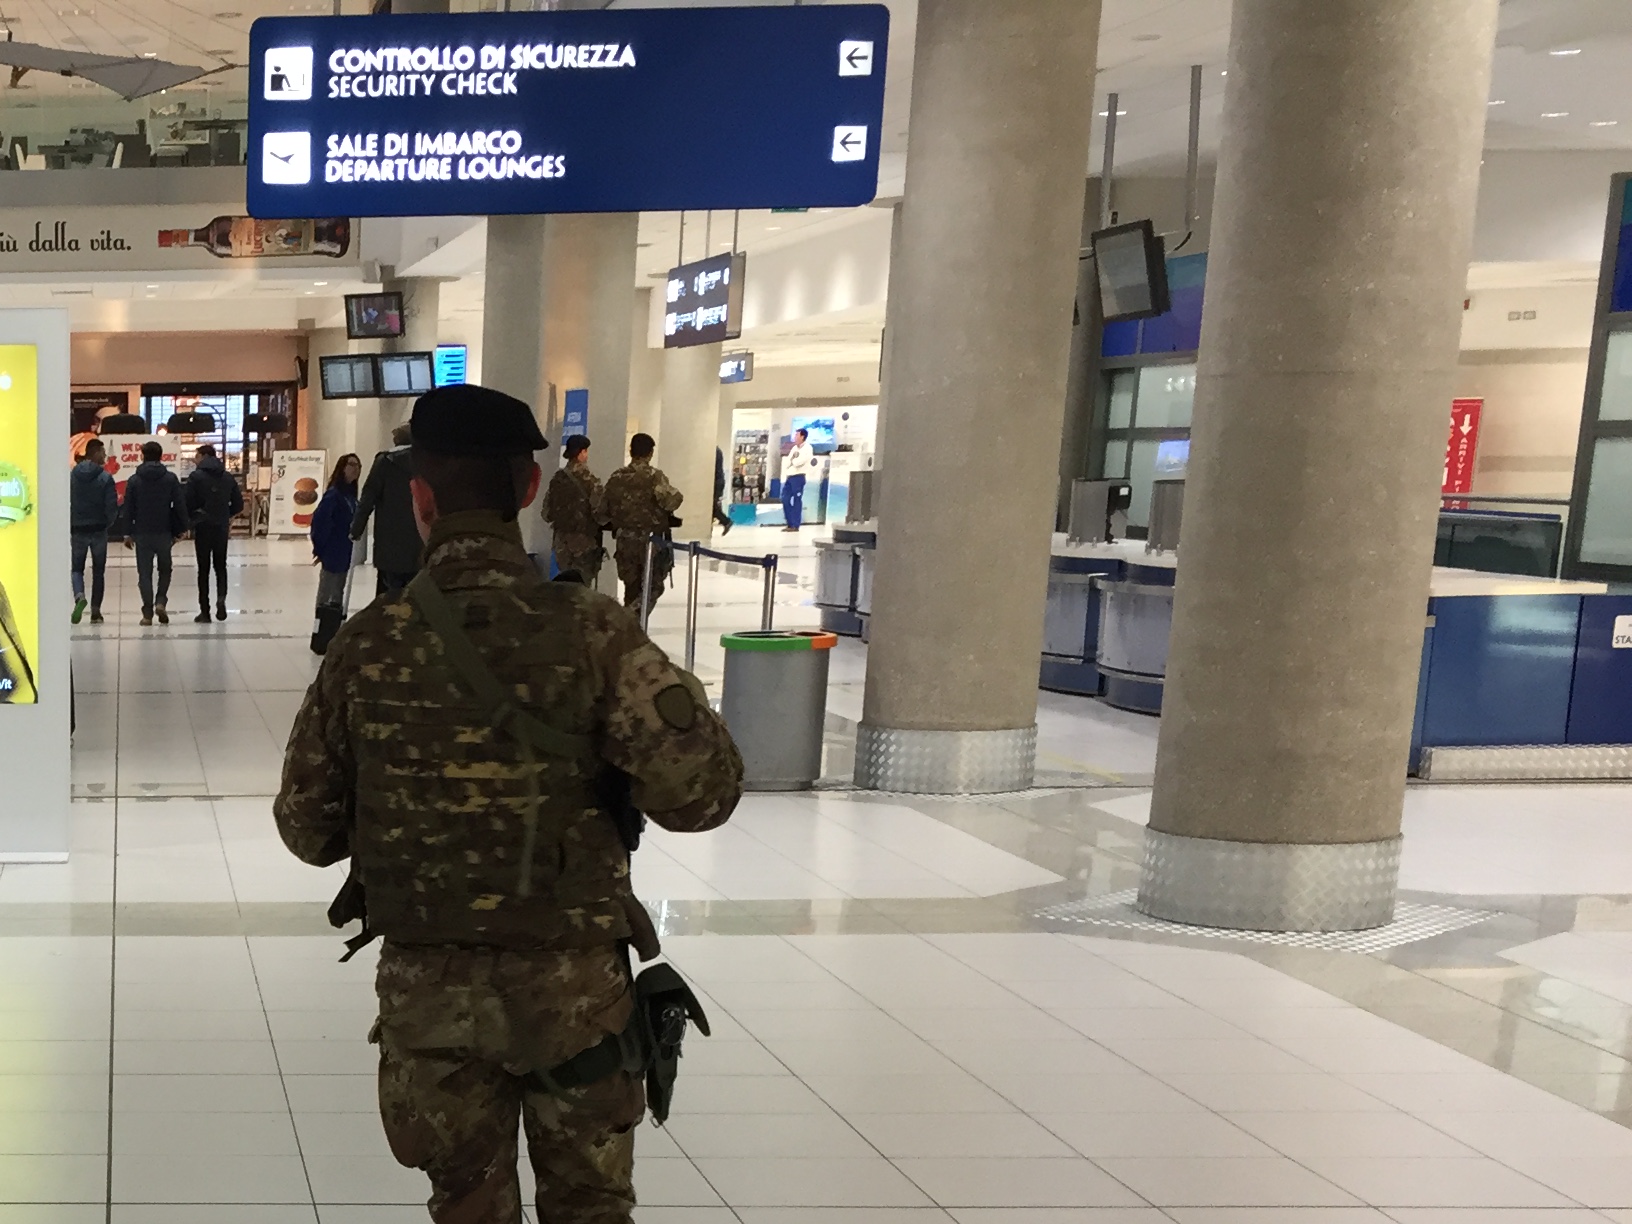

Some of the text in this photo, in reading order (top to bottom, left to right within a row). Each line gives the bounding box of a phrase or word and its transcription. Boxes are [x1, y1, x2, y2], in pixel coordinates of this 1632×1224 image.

[328, 43, 636, 73] CONTROLLO DI SICUREZZA
[328, 72, 518, 98] SECURITY CHECK
[326, 130, 522, 158] SALE DI IMBARCO
[325, 155, 566, 183] DEPARTURE LOUNGES
[29, 221, 80, 252] dalla
[90, 230, 131, 252] vita.
